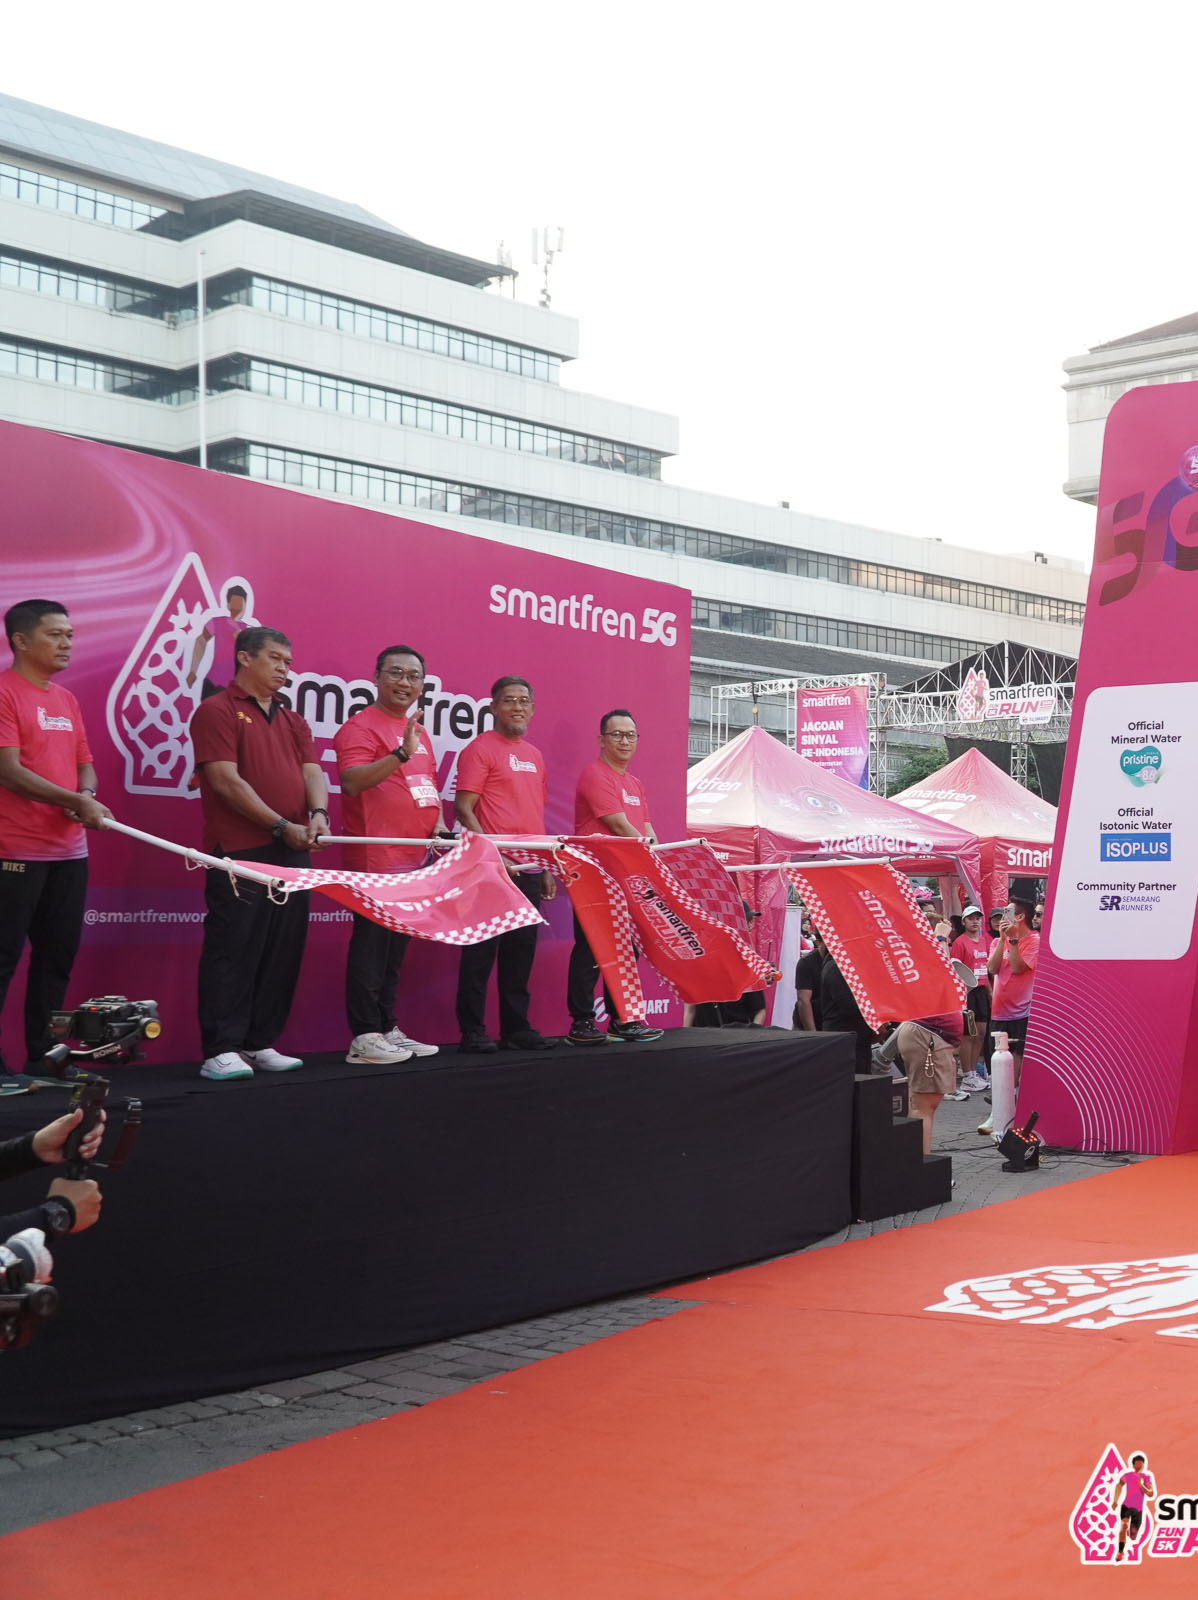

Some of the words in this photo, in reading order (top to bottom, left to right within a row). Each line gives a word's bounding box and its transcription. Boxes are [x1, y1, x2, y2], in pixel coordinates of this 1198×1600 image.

[489, 584, 636, 641] smartfren
[640, 608, 677, 647] 5G
[989, 684, 1053, 701] smartfren
[802, 694, 851, 708] smartfren
[274, 678, 496, 740] smafren
[999, 701, 1040, 716] RUN
[801, 720, 844, 732] JAGOAN
[1127, 721, 1164, 731] Official
[801, 734, 839, 745] SINYAL
[1111, 734, 1148, 744] Mineral
[1150, 734, 1182, 743] Water
[800, 746, 864, 758] SE-INDONESIA
[1123, 754, 1159, 767] pristine
[1117, 808, 1153, 817] Official
[1100, 821, 1139, 831] Isotonic
[1141, 821, 1172, 830] Water
[819, 833, 907, 853] smartfren
[1105, 841, 1169, 858] ISOPLUS
[2, 861, 26, 873] NIKE
[1076, 882, 1136, 893] Community
[1139, 882, 1177, 891] Partner
[1099, 895, 1122, 911] SR
[655, 901, 705, 956] smartfren
[859, 890, 920, 984] smartfren
